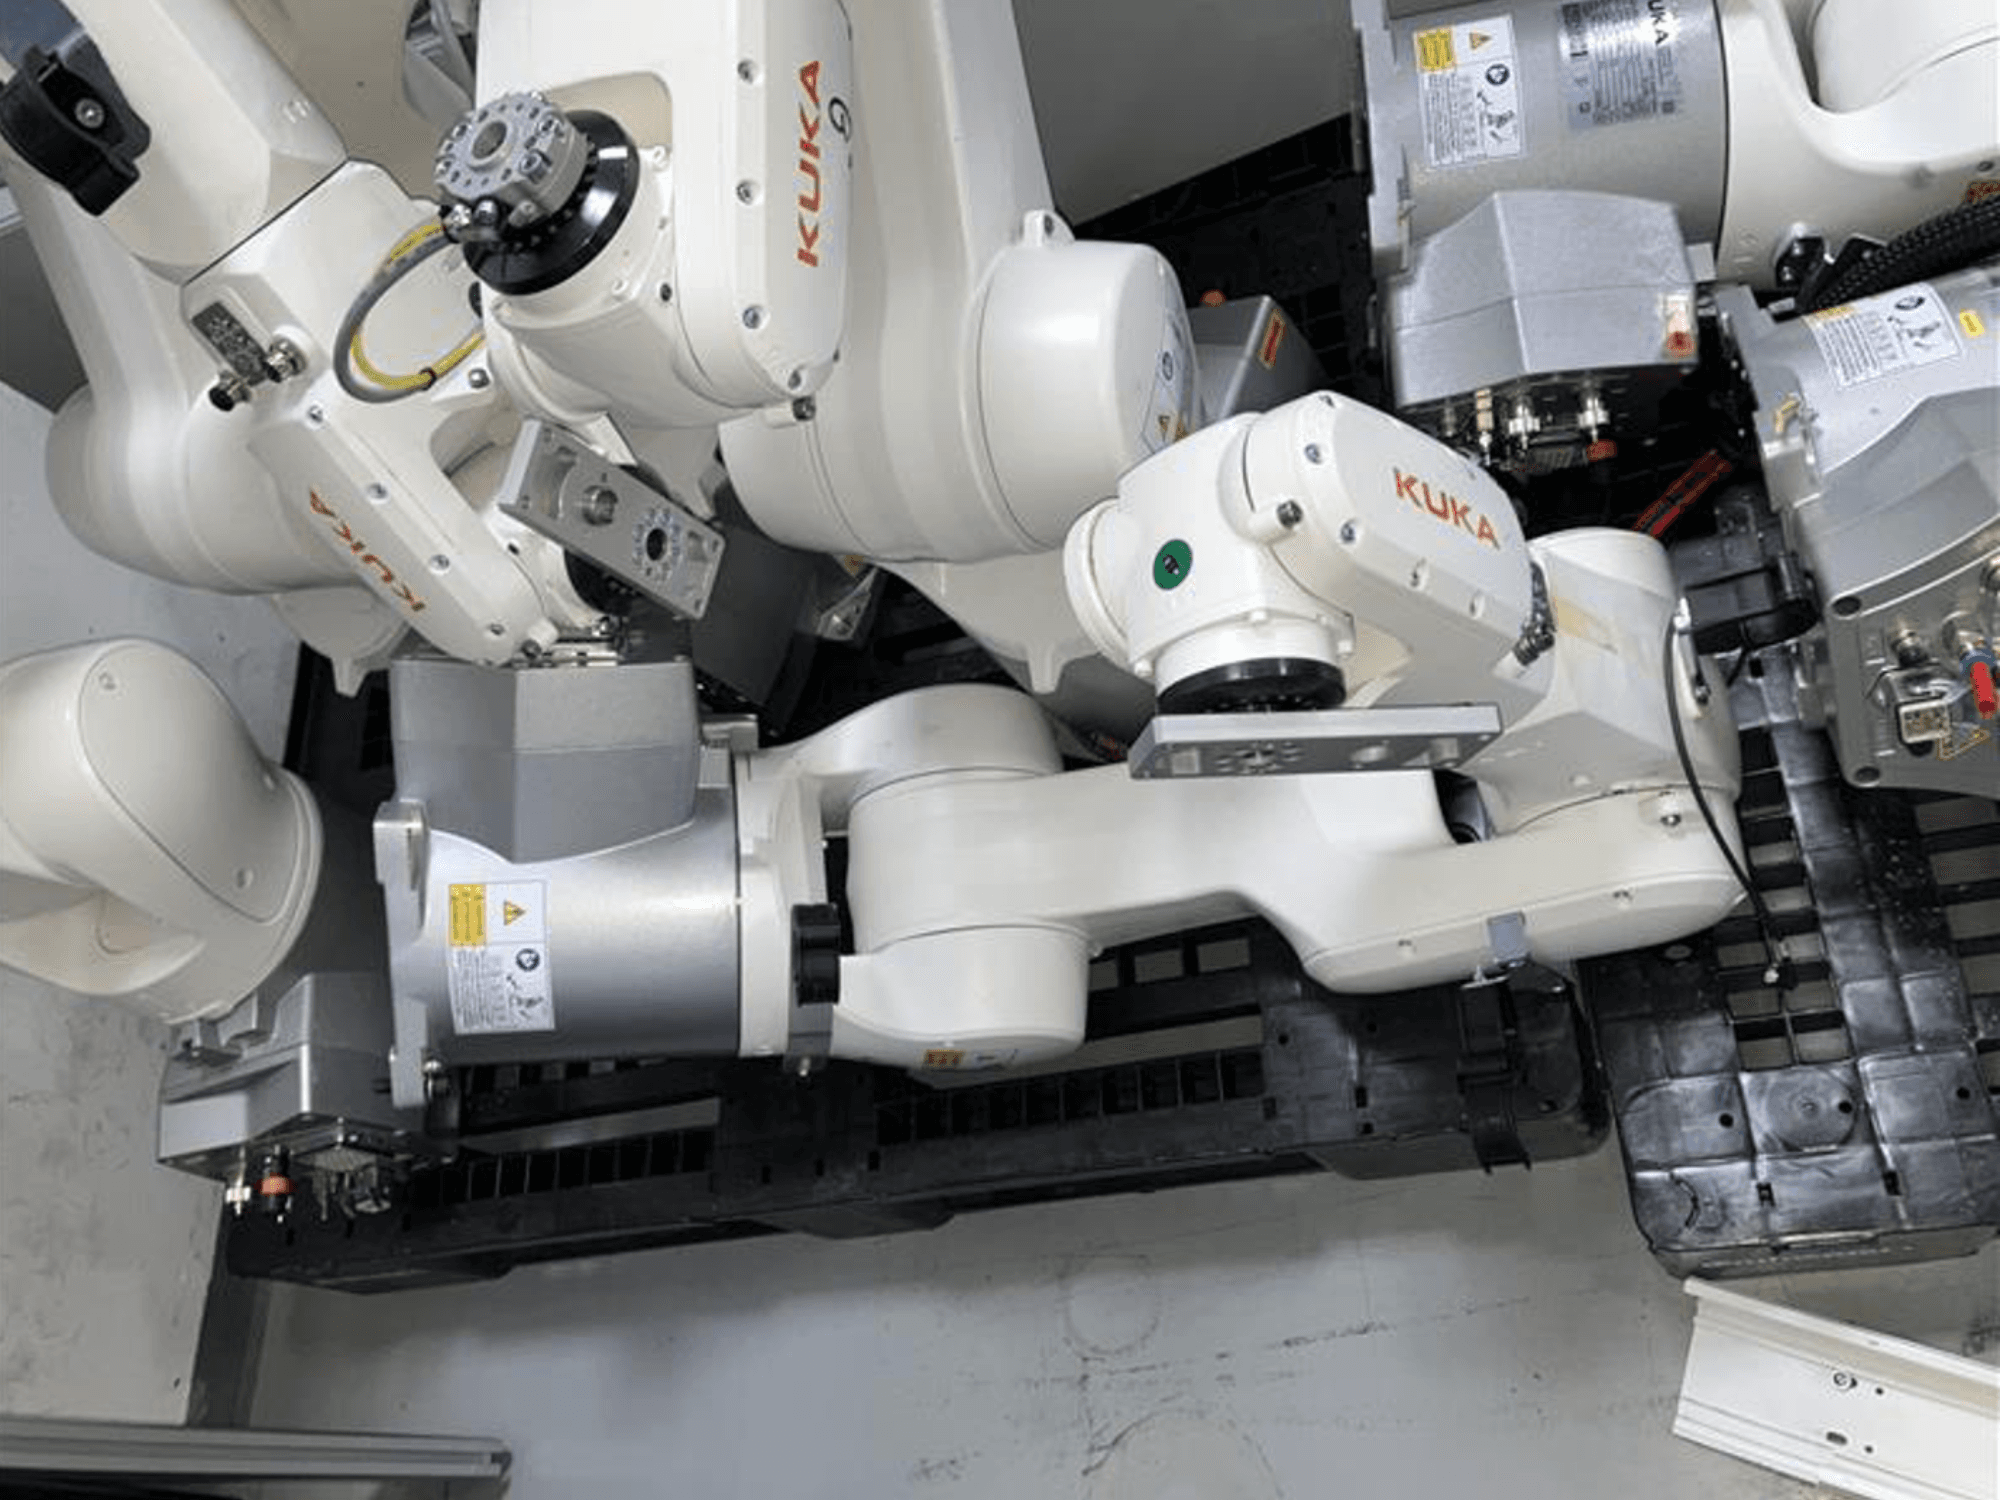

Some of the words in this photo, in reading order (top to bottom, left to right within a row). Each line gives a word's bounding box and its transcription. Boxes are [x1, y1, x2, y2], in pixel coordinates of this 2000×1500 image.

[798, 61, 820, 267] KUKA
[309, 486, 426, 612] KUKA
[1393, 467, 1500, 550] KUKA
